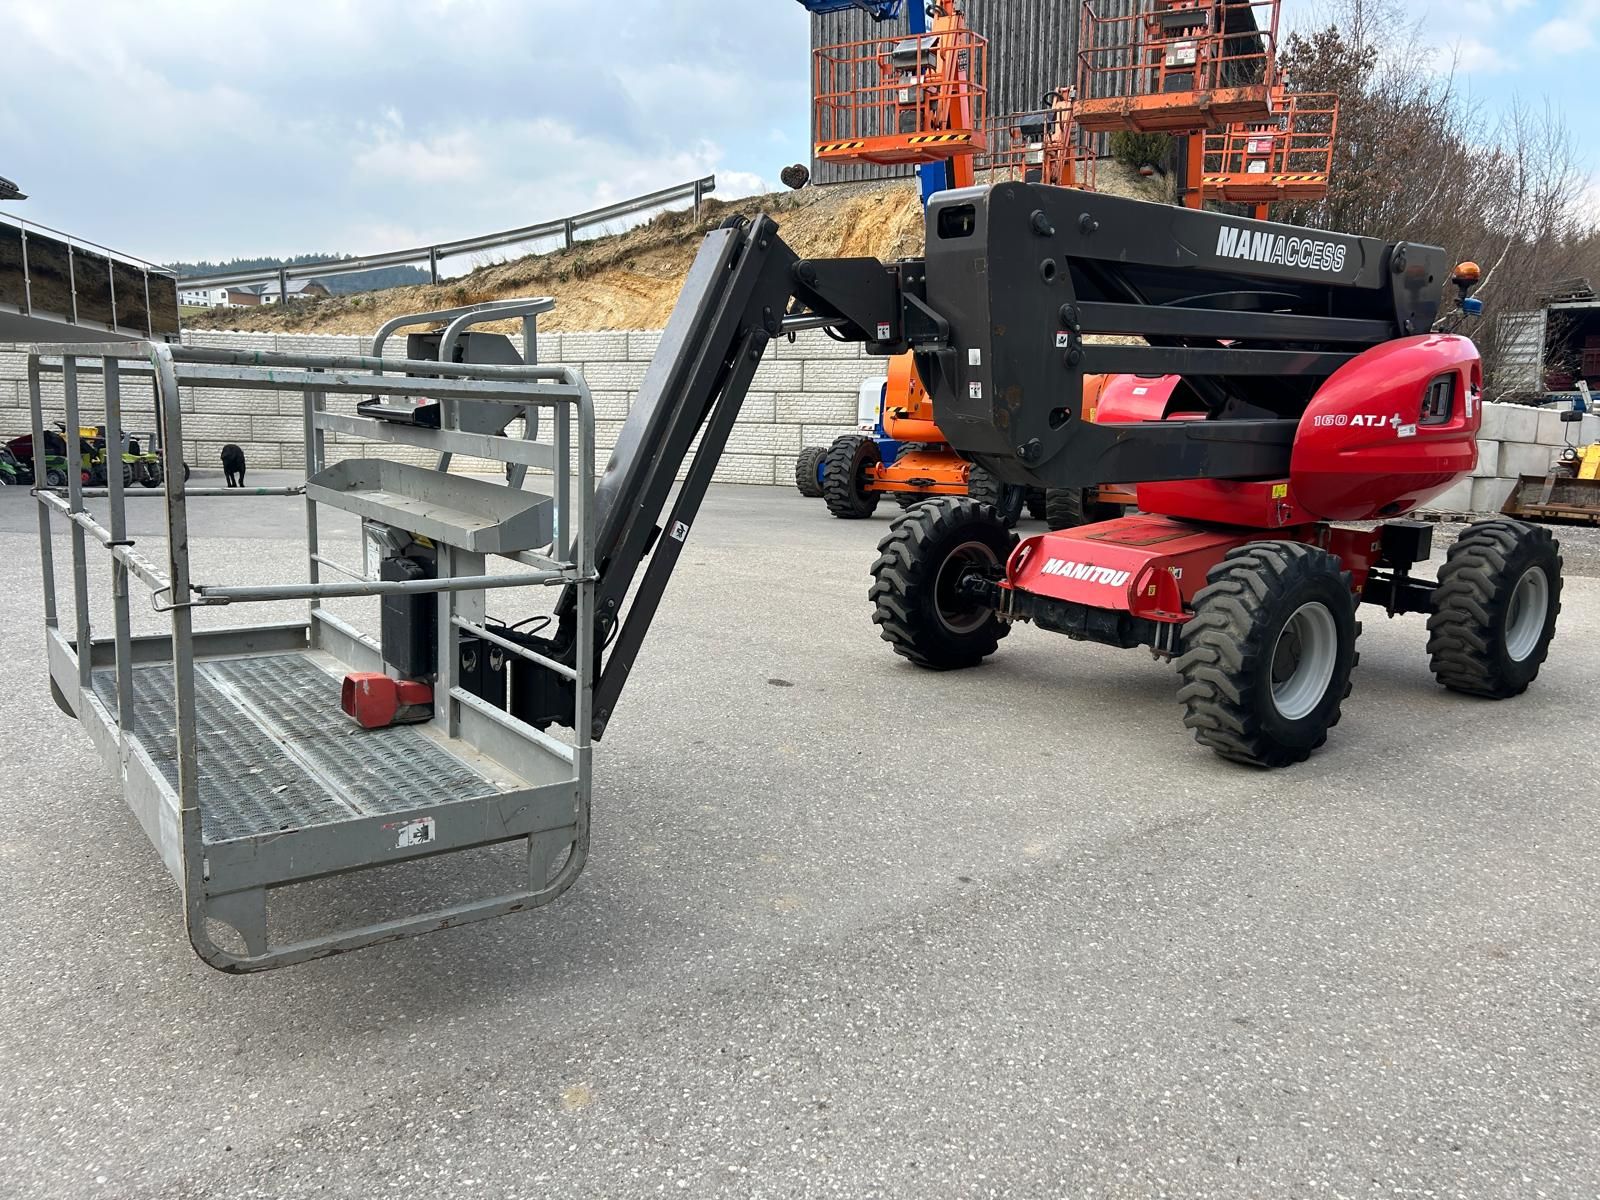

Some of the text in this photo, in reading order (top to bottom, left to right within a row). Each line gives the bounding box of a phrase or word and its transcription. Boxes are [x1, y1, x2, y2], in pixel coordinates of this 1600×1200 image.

[1215, 225, 1347, 273] MANIACCESS
[1313, 414, 1348, 427] 160
[1041, 558, 1131, 587] MANITOU
